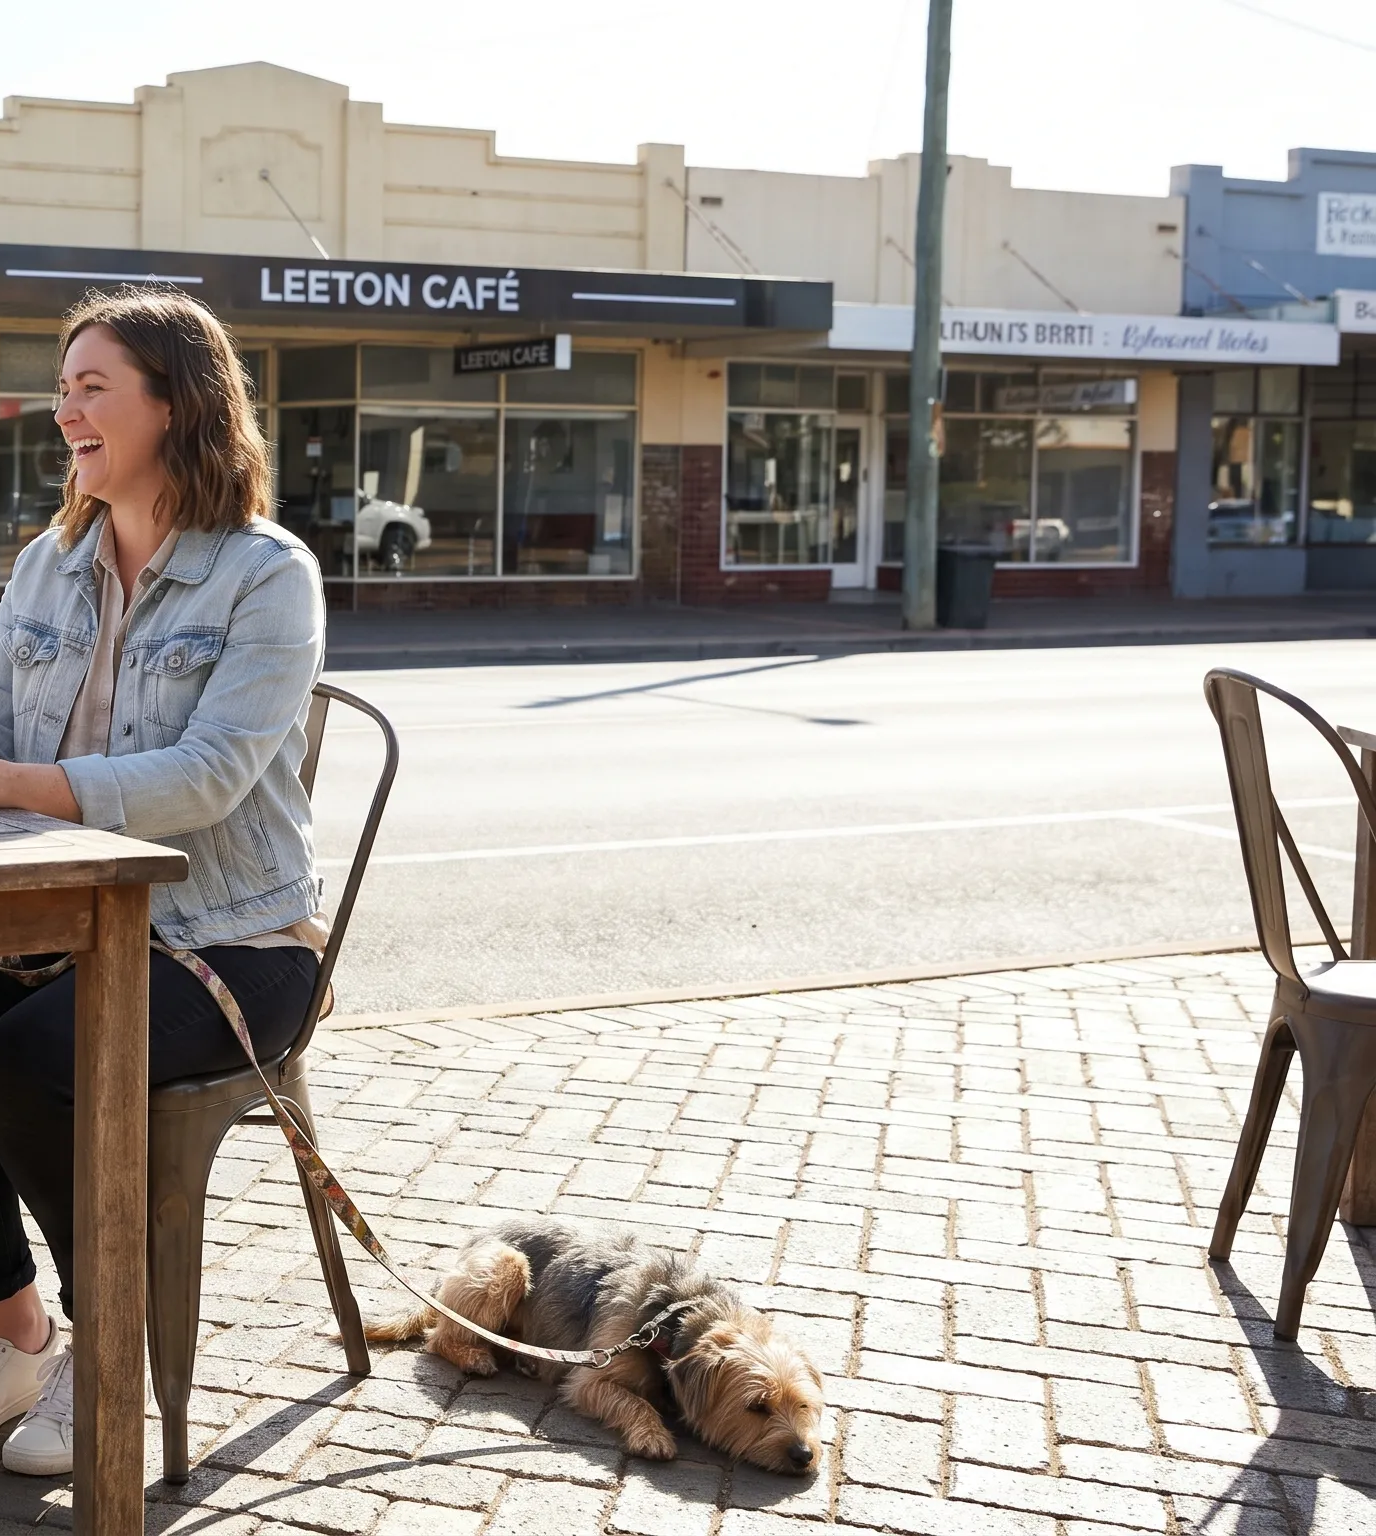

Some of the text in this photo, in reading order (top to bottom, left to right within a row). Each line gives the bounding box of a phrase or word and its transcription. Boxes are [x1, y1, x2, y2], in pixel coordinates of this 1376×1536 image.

[261, 267, 520, 312] LEETON CAFÉ
[460, 341, 549, 370] LEETON CAFÉ
